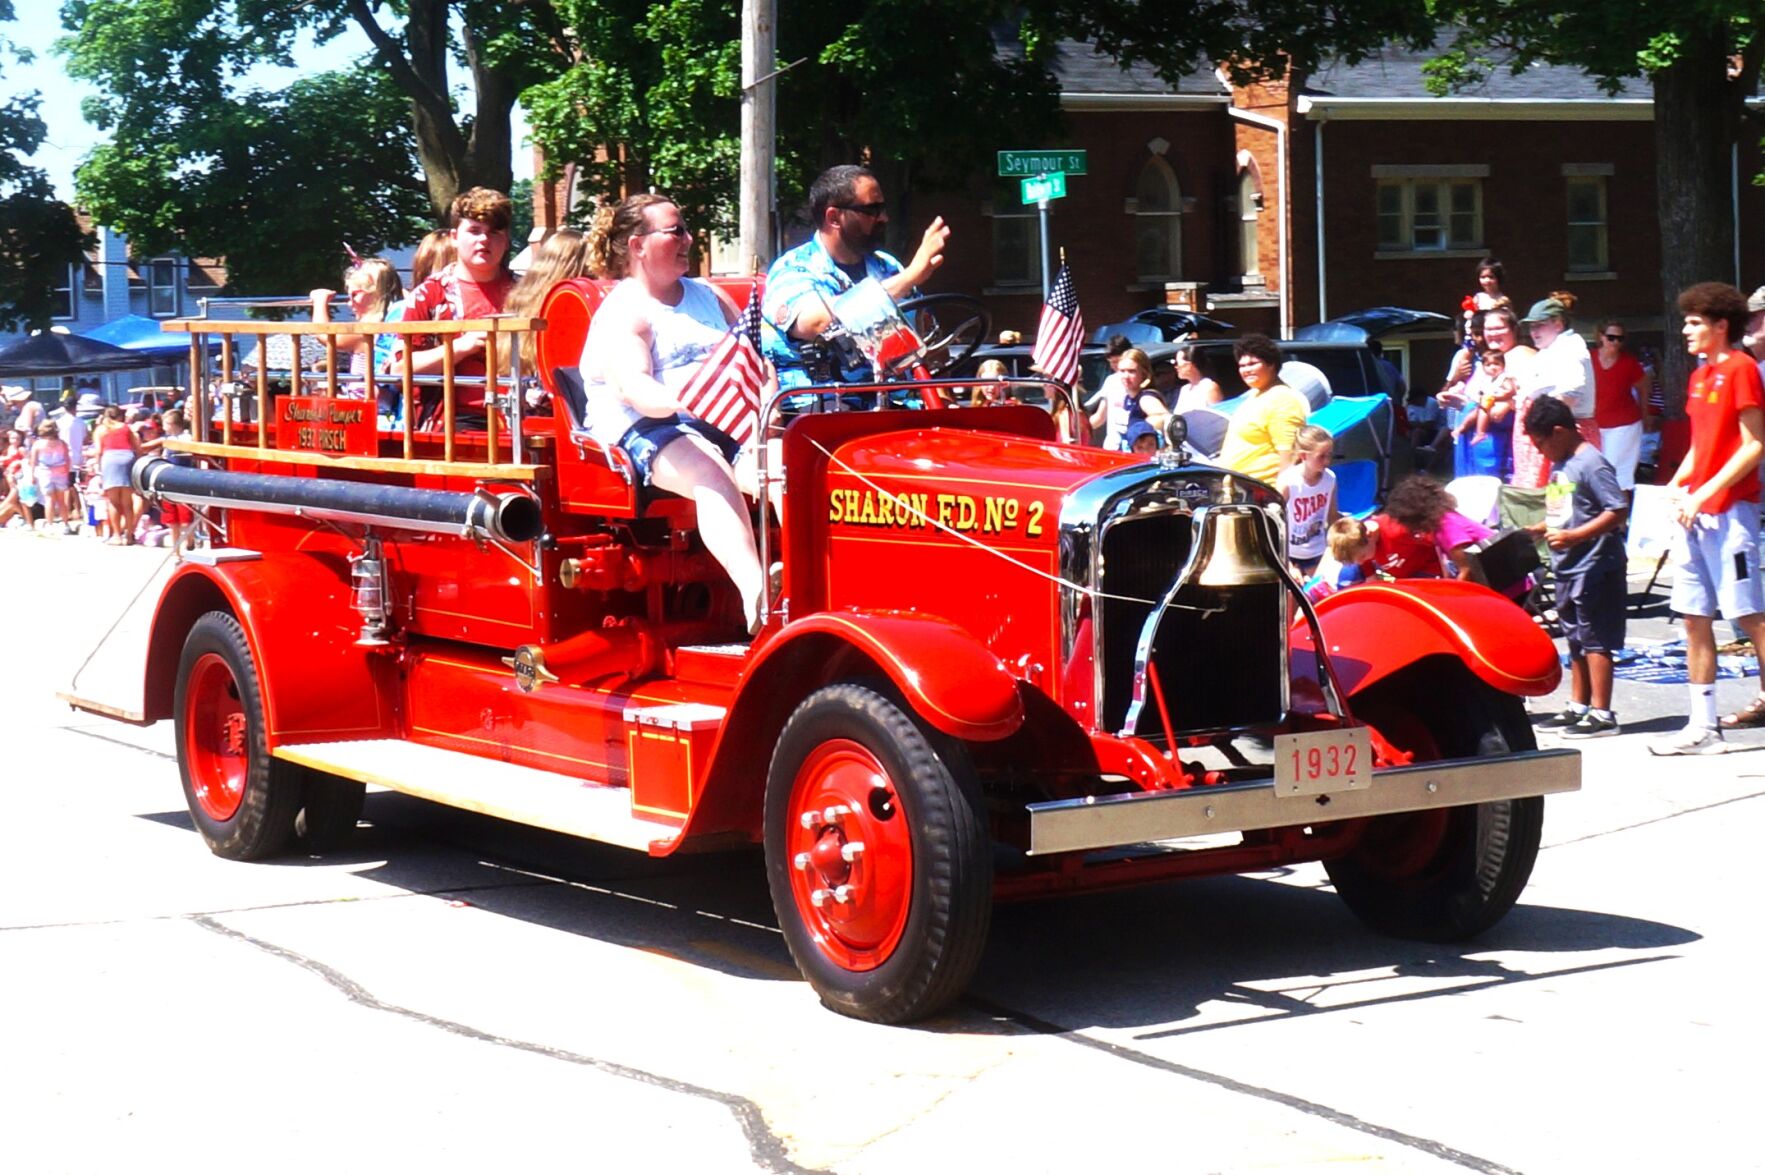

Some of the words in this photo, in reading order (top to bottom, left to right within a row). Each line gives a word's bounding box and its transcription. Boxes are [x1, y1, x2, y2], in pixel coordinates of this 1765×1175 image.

[1006, 153, 1062, 173] Seymour
[1069, 156, 1080, 169] St
[829, 489, 928, 527] SHARON
[1027, 501, 1044, 535] 2
[1291, 744, 1357, 782] 1932
